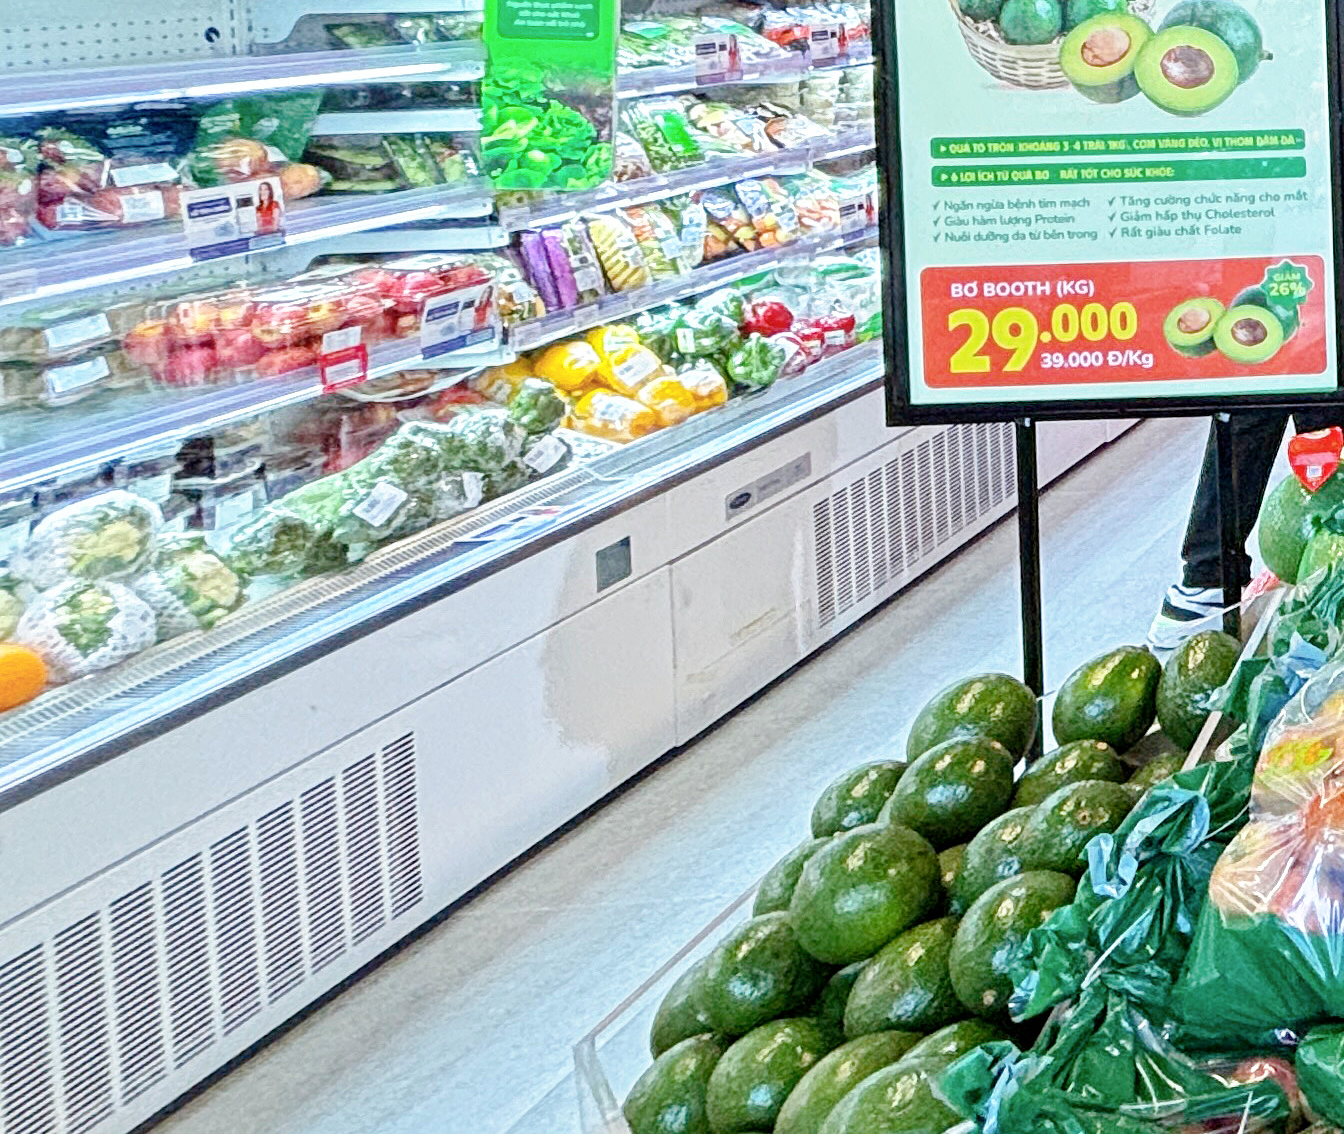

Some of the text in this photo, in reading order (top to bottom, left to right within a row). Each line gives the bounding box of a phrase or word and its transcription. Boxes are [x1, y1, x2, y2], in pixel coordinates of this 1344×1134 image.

[1038, 198, 1056, 208] tim
[1060, 197, 1090, 210] mạch
[1120, 195, 1151, 207] Tăng
[1194, 192, 1222, 204] chức
[1225, 192, 1255, 204] năng
[1259, 191, 1280, 202] cho
[1035, 214, 1075, 224] Protein
[1205, 207, 1275, 219] Cholesterol
[1012, 230, 1026, 240] da
[1067, 230, 1098, 240] trong
[1145, 227, 1171, 239] giàu
[1174, 225, 1200, 236] chất
[1205, 224, 1242, 235] Folate
[983, 281, 1051, 297] BOOTH
[1056, 278, 1095, 298] (KG)
[1268, 281, 1306, 298] 26%
[948, 301, 1138, 374] 29.000
[1040, 349, 1154, 369] 39.000 Đ/Kg
